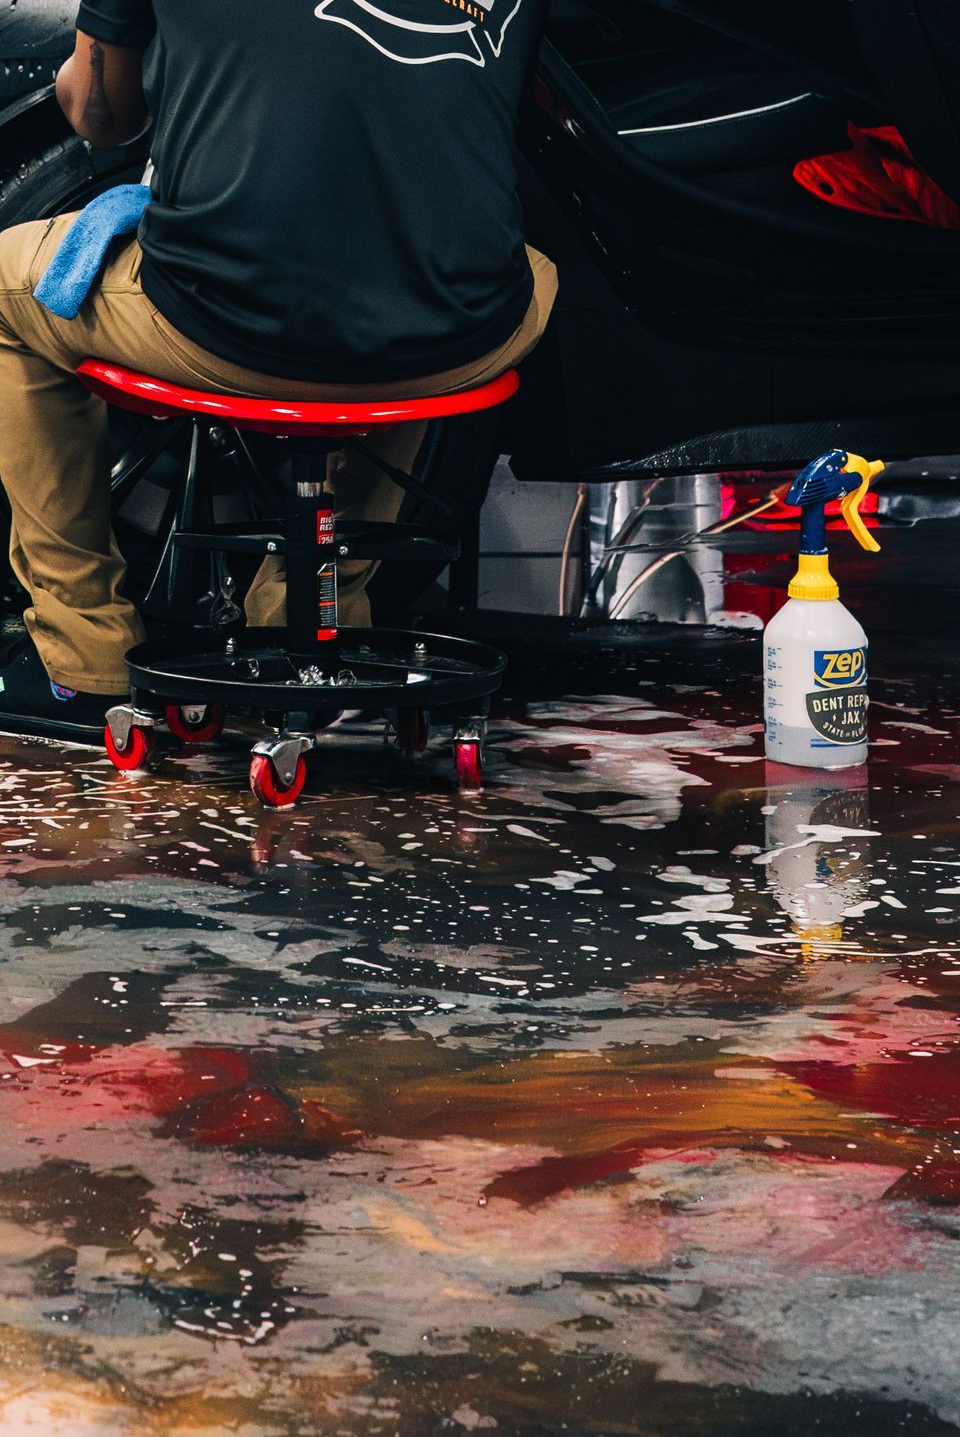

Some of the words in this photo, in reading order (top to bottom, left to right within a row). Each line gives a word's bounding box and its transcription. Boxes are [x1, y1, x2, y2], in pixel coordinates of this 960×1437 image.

[812, 696, 843, 712] DENT
[842, 711, 860, 725] JAX
[823, 722, 844, 738] STATE
